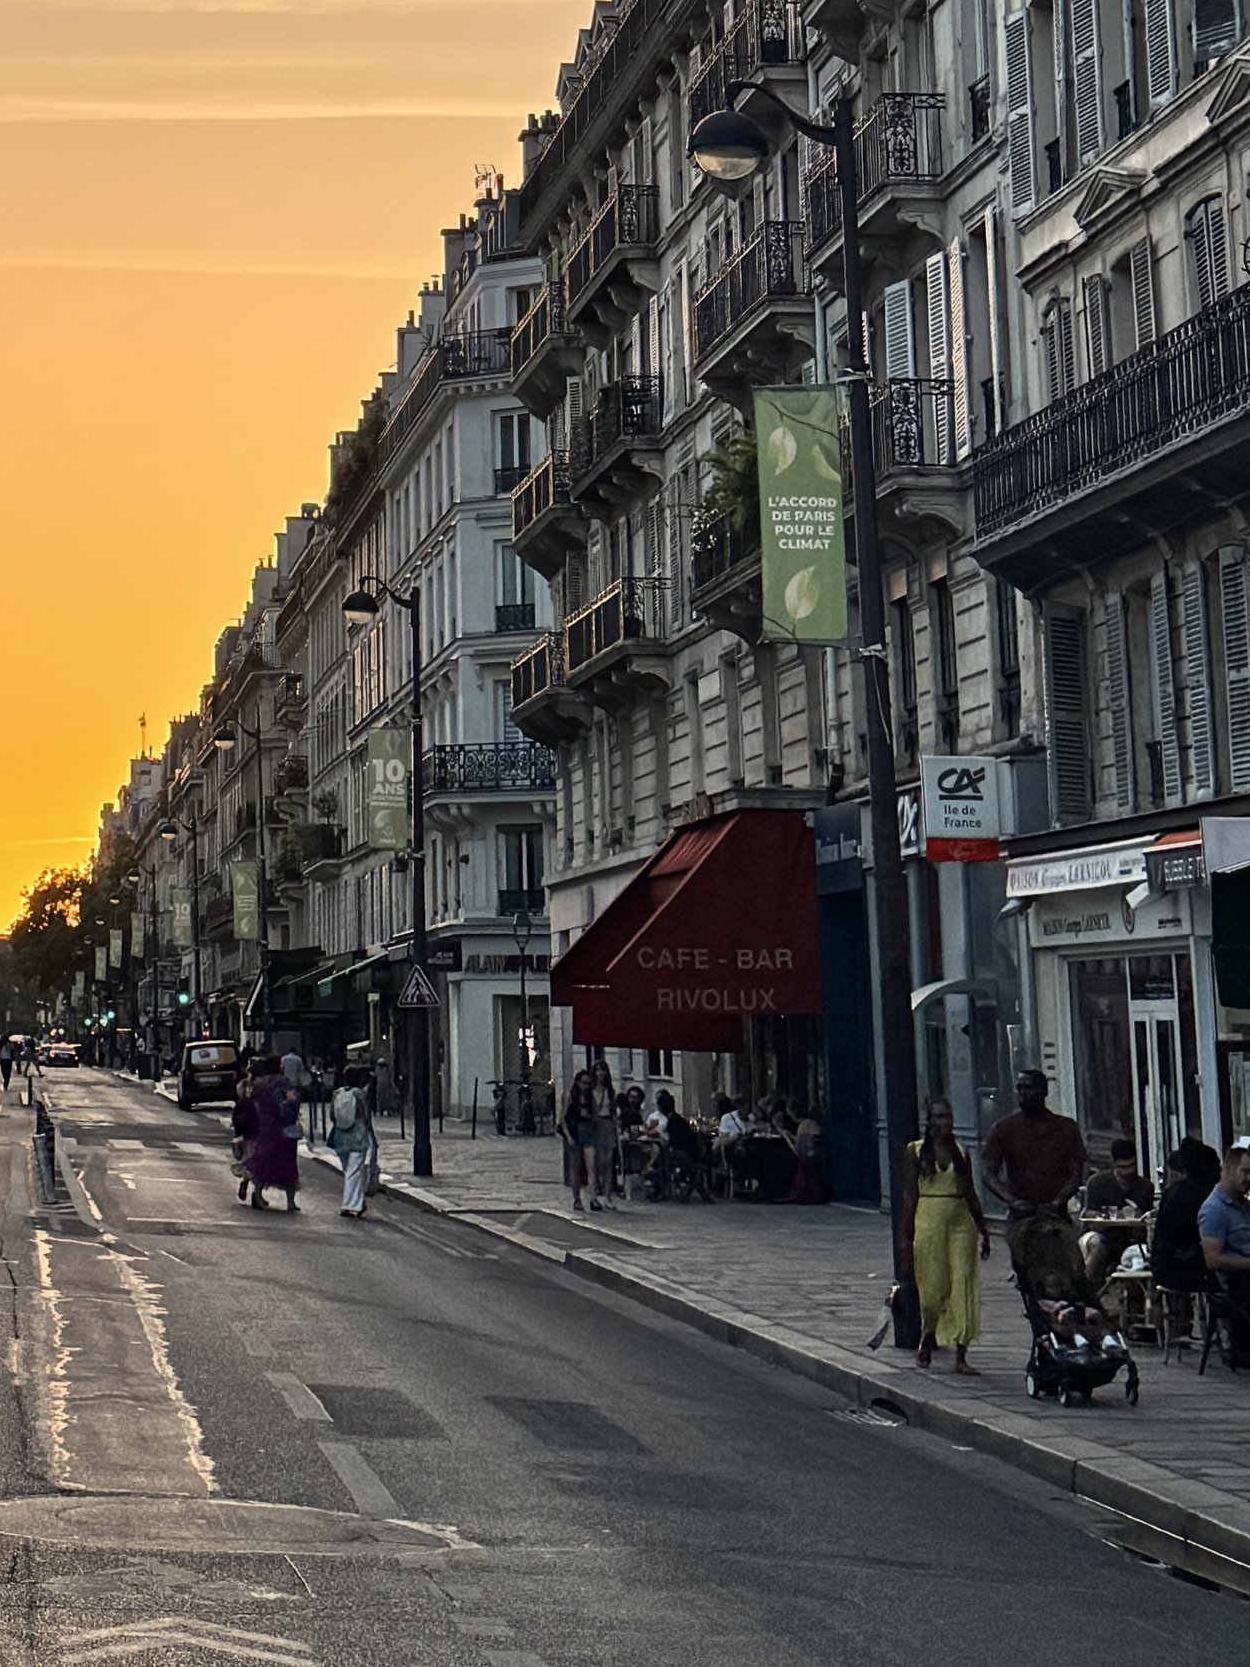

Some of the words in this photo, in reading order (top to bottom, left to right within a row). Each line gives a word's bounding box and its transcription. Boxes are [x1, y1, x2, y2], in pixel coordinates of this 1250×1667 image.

[768, 496, 837, 507] L'ACCORD
[772, 511, 791, 521] DE
[794, 511, 835, 521] PARIS
[775, 524, 814, 535] POUR
[818, 525, 835, 536] LE
[779, 538, 831, 550] CLIMAT
[372, 758, 406, 783] 10
[372, 783, 405, 795] ANS
[961, 805, 977, 815] de
[944, 817, 983, 828] France
[637, 947, 710, 969] CAFE
[736, 948, 794, 970] BAR
[657, 987, 778, 1011] RIVOLUX
